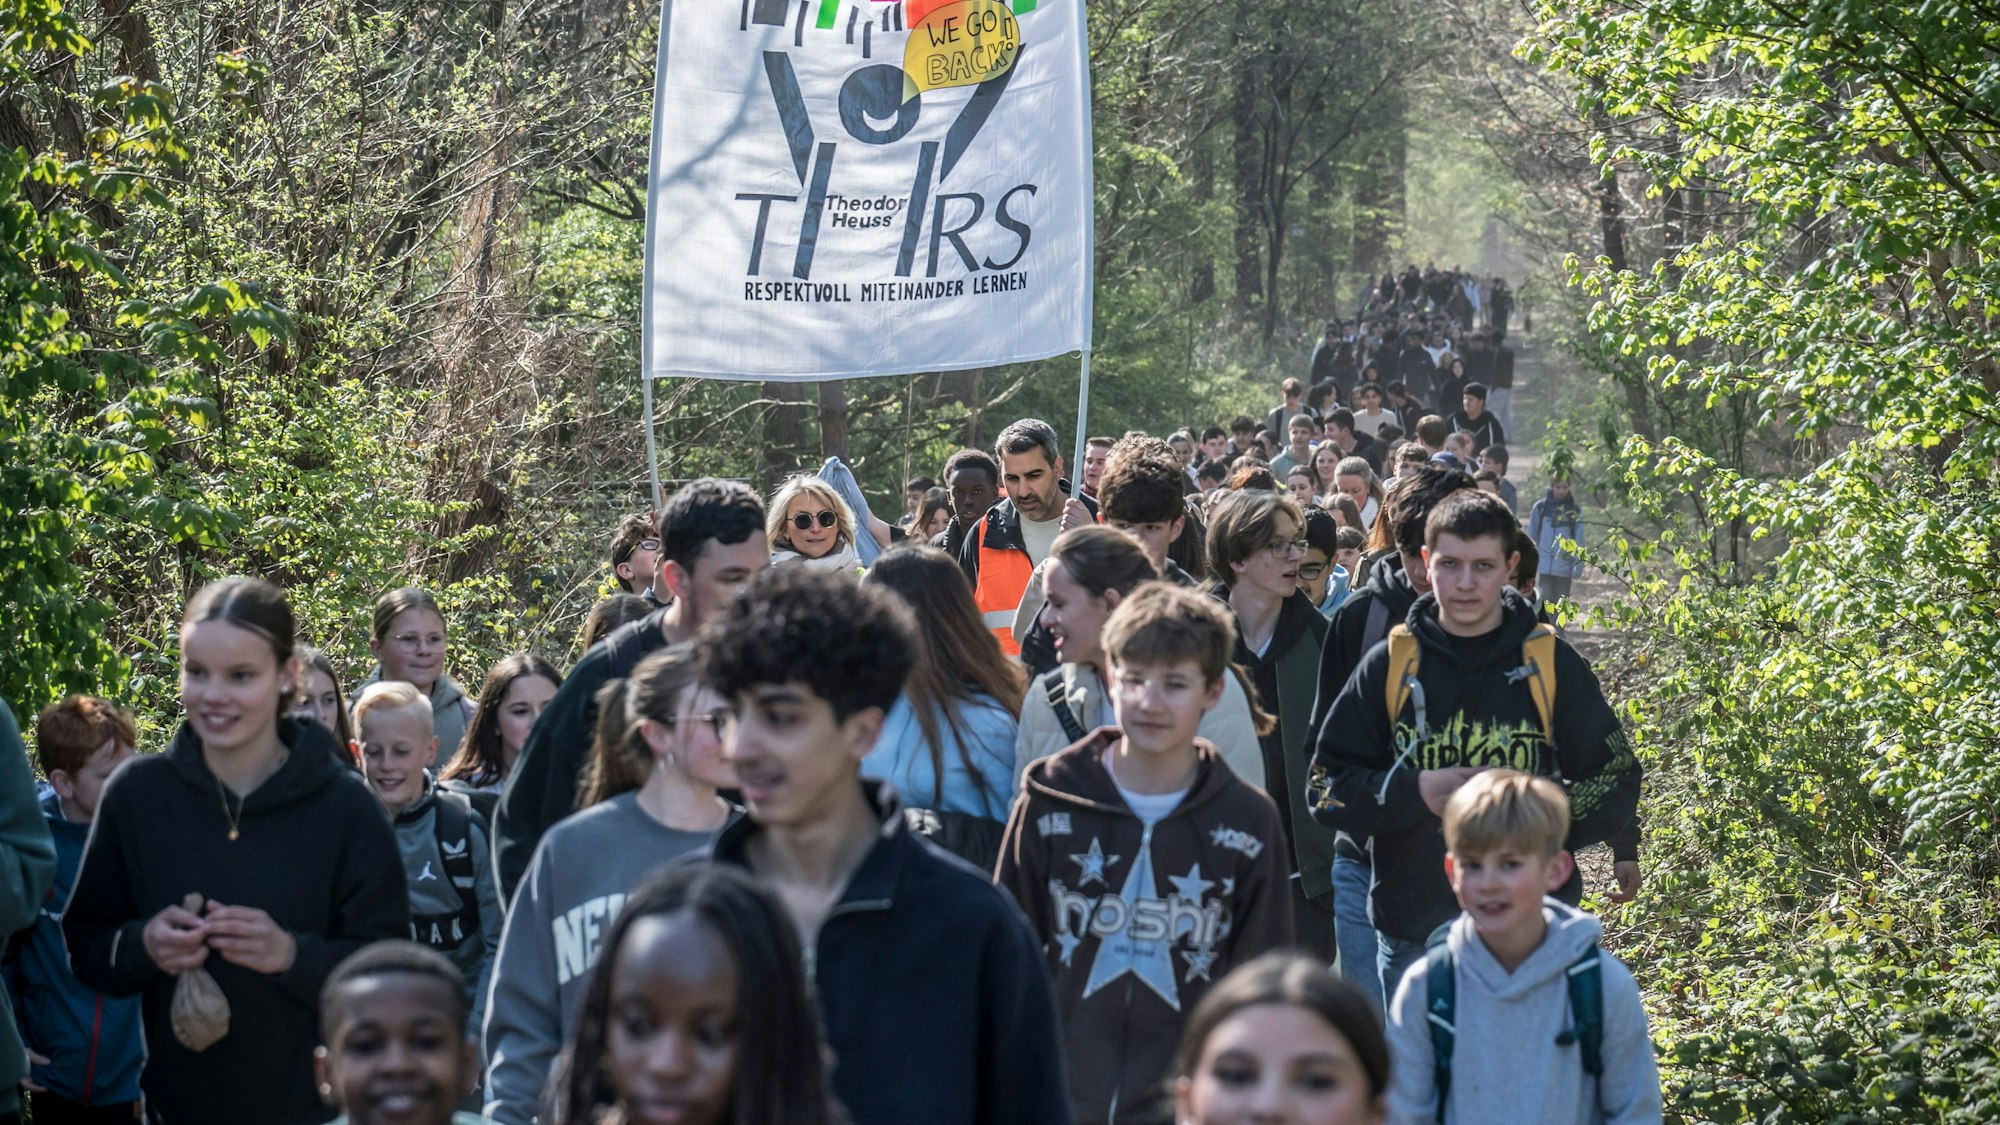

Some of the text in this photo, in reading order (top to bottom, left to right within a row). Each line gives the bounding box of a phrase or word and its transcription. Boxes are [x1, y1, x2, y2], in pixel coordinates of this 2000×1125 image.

[926, 9, 998, 48] WE GO
[825, 194, 908, 212] Theodor
[831, 213, 893, 229] Heuss
[744, 271, 1028, 303] RESPEKTVOLL MITEINANDER LERNEN
[1052, 888, 1222, 949] hoshi
